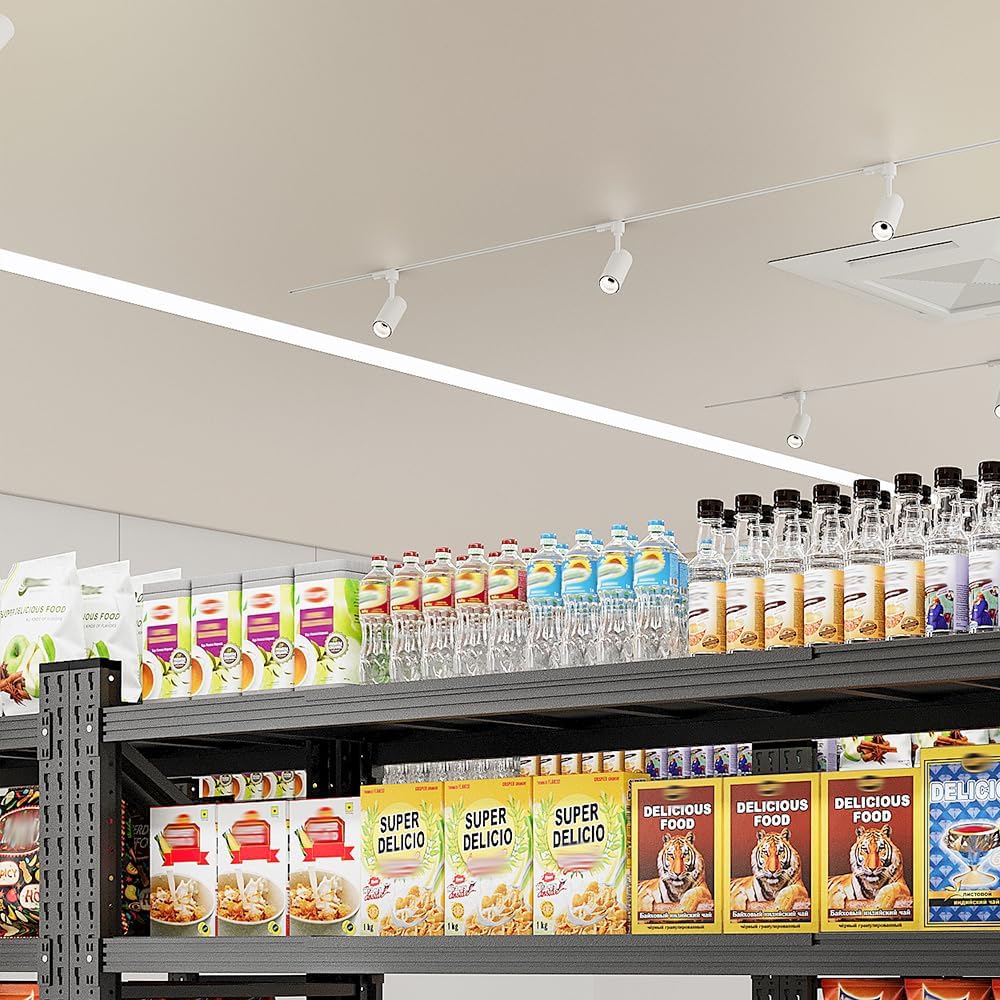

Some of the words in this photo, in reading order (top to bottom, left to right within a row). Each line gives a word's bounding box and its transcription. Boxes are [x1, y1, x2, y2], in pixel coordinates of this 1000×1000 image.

[46, 604, 67, 614] FOOD
[100, 612, 121, 621] FOOD
[643, 802, 712, 818] DELICIOUS
[736, 799, 808, 814] DELICIOUS
[834, 794, 910, 810] DELICIOUS
[465, 807, 507, 830] SUPER
[554, 802, 599, 826] SUPER
[754, 814, 790, 827] FOOD
[852, 810, 892, 823] FOOD
[380, 812, 420, 834] SUPER
[660, 818, 696, 830] FOOD
[378, 831, 425, 854] DELICIO
[463, 827, 513, 851] DELICIO
[552, 824, 605, 848] DELICIO
